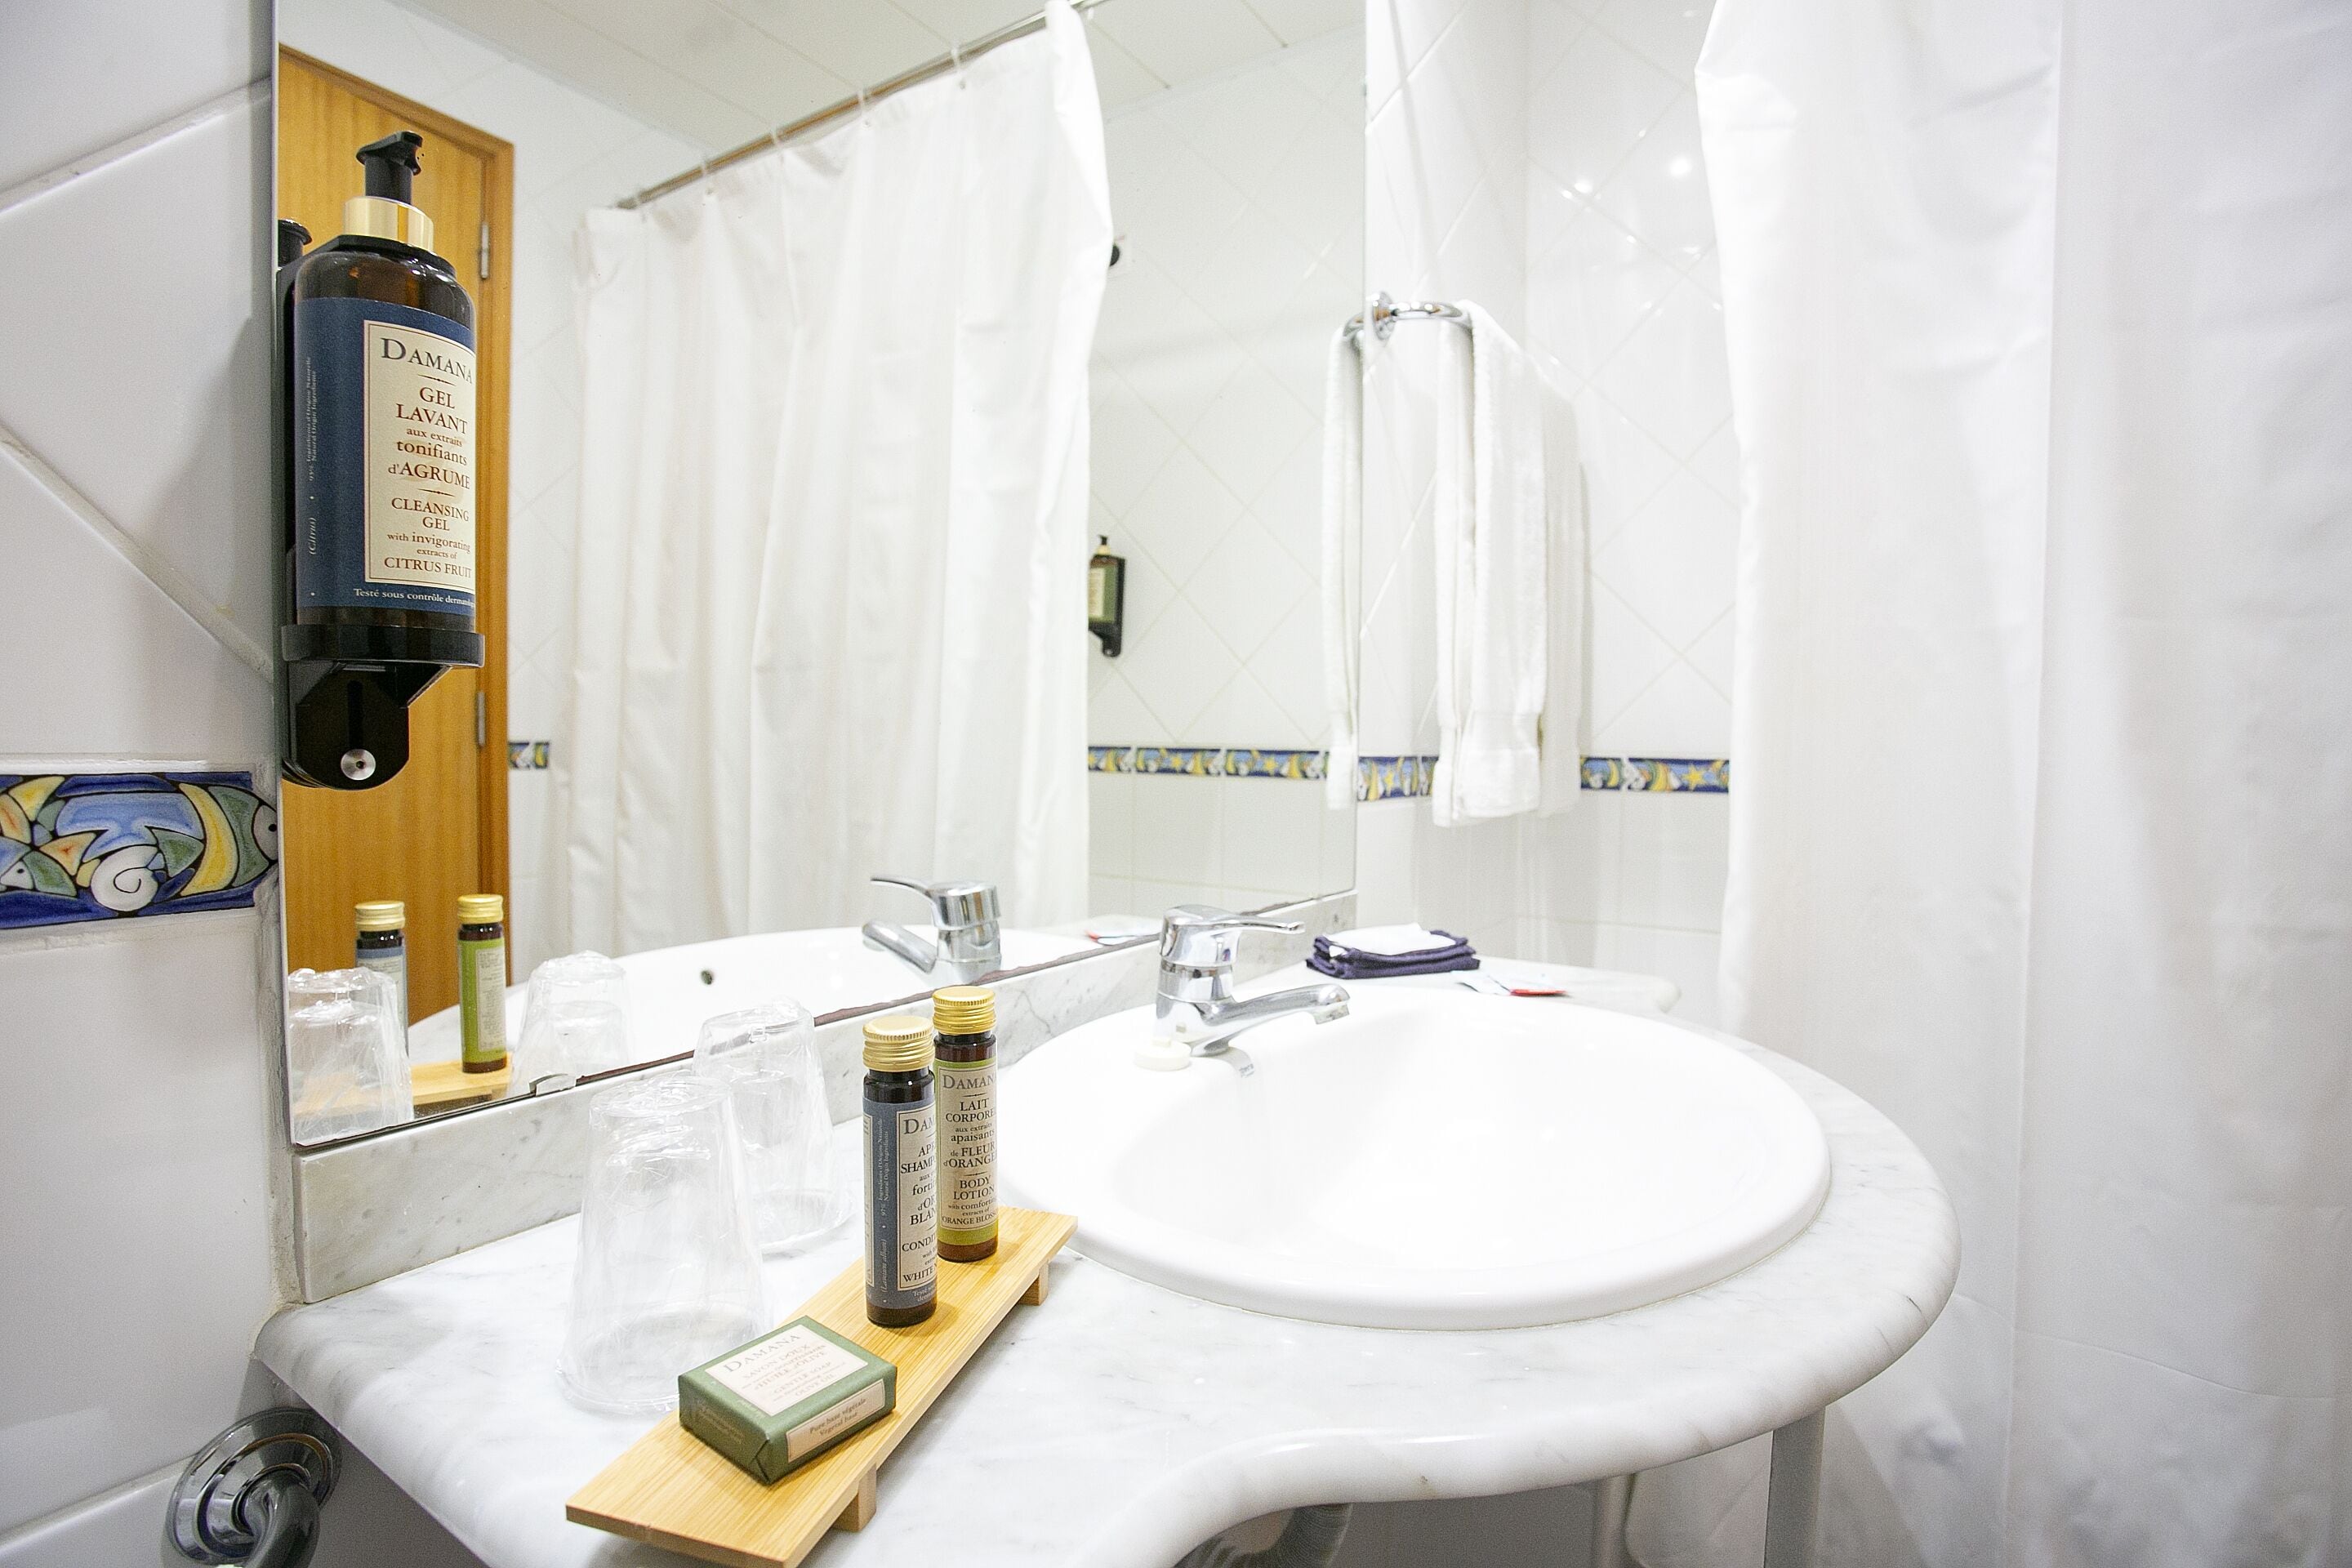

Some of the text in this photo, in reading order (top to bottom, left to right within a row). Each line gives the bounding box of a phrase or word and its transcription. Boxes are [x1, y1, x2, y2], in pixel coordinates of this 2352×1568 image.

[381, 337, 473, 384] DAMANA
[420, 386, 455, 408] GEL
[395, 403, 467, 434] LAVANT
[407, 427, 462, 447] aux extraits
[397, 440, 467, 466] tonifiants
[388, 461, 470, 490] d'AGRUME
[392, 497, 470, 522] CLEANSING
[422, 516, 450, 531] GEL
[387, 532, 470, 553] with invigorating
[416, 548, 449, 559] extracts
[384, 557, 441, 572] CITRUS
[353, 588, 379, 598] Testé
[382, 590, 404, 599] sous
[407, 593, 443, 603] contrôle
[960, 1098, 989, 1111] LAIT
[970, 1122, 992, 1132] extraits
[951, 1129, 995, 1144] apaisants
[961, 1142, 995, 1157] FLEUR
[960, 1175, 991, 1189] BODY
[954, 1185, 995, 1200] LOTION
[942, 1215, 974, 1225] ORANGE
[962, 1209, 983, 1217] extracts
[721, 1332, 802, 1373] DAMANA
